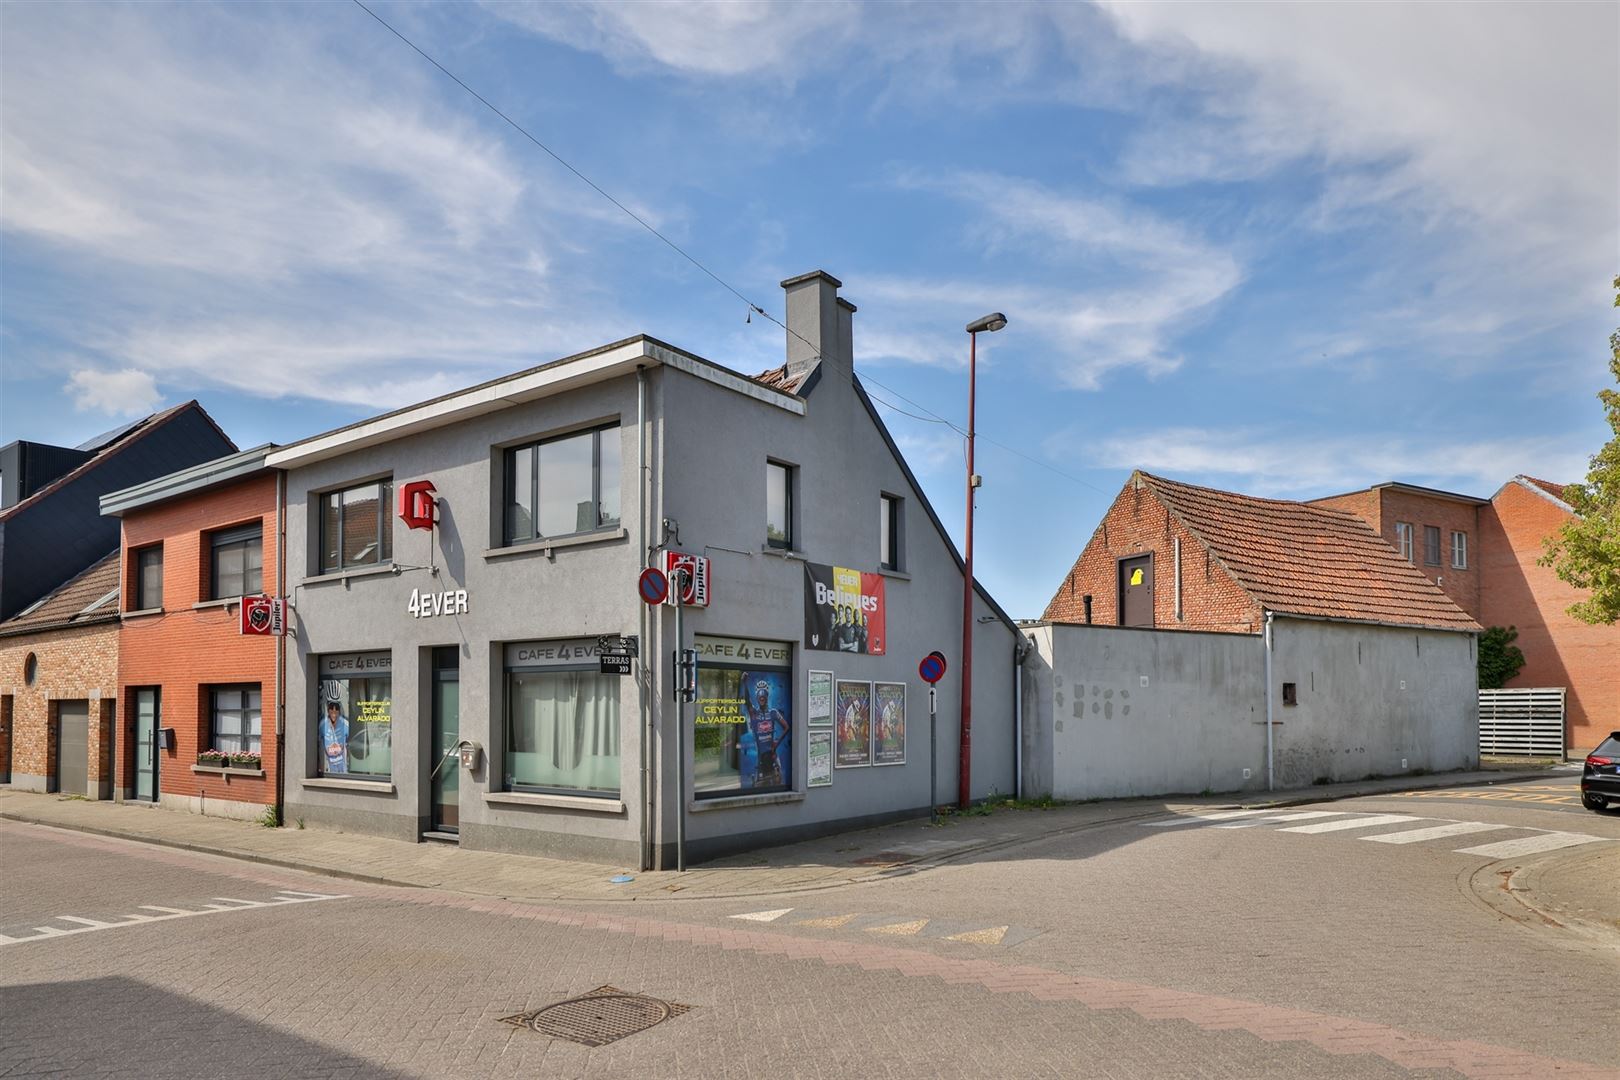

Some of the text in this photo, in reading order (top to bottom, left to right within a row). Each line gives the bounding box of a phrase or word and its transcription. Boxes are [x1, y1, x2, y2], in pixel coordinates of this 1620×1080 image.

[697, 558, 705, 603] Jupiler
[408, 588, 469, 618] 4EVER
[815, 582, 878, 612] Believes
[273, 601, 282, 632] Jupiler
[518, 648, 555, 661] CAFE
[557, 644, 571, 661] 4
[694, 642, 789, 660] CAFE 4 EVER
[329, 656, 392, 671] CAFE 4 EVER
[602, 656, 630, 665] TERRAS
[703, 706, 738, 714] CEYLIN
[695, 716, 746, 724] ALVARADO
